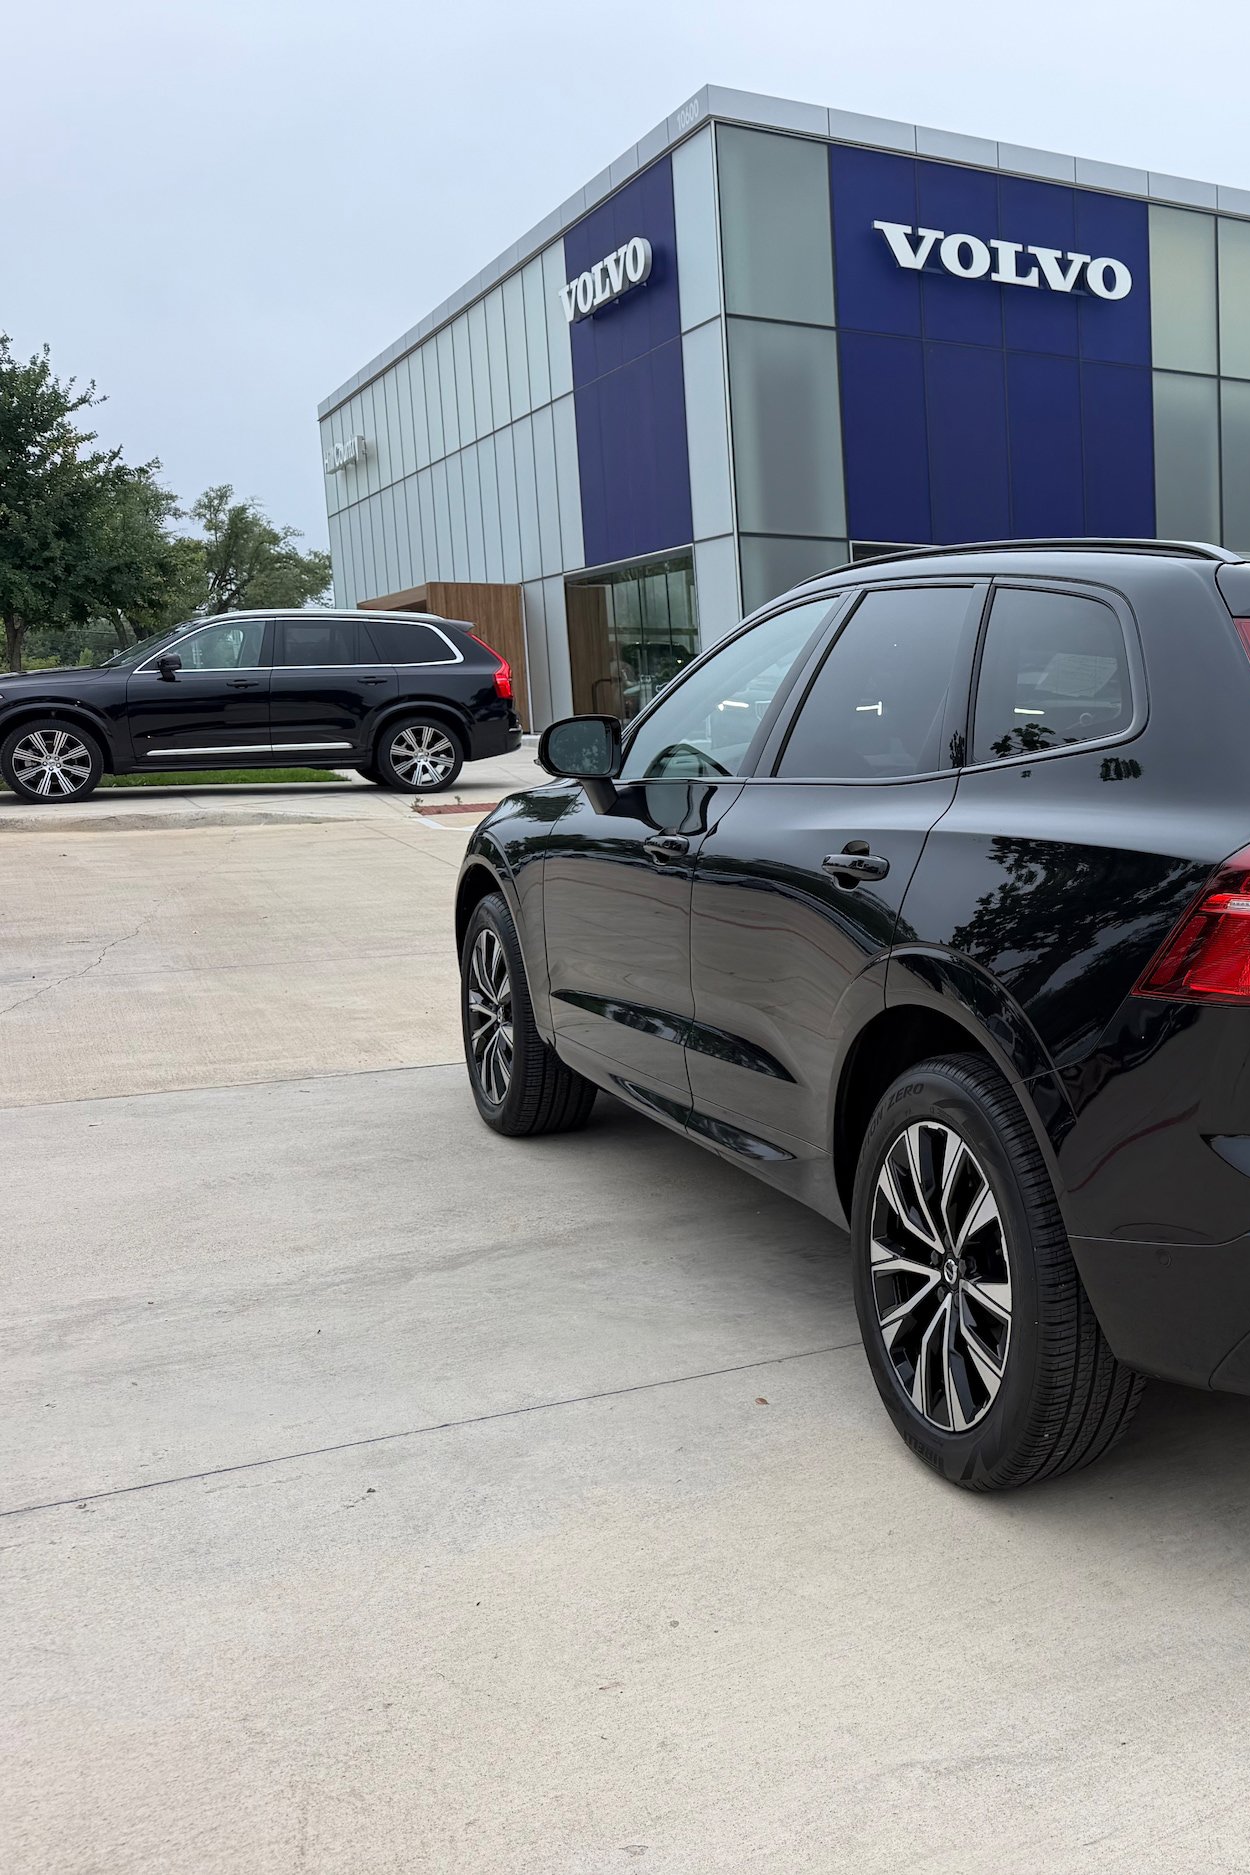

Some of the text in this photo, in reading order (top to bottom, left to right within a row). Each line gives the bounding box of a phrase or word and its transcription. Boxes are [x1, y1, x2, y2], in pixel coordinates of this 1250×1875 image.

[677, 98, 699, 131] 10600
[558, 236, 651, 323] VOLVO
[873, 219, 1133, 301] VOLVO
[886, 1083, 925, 1112] ZERO
